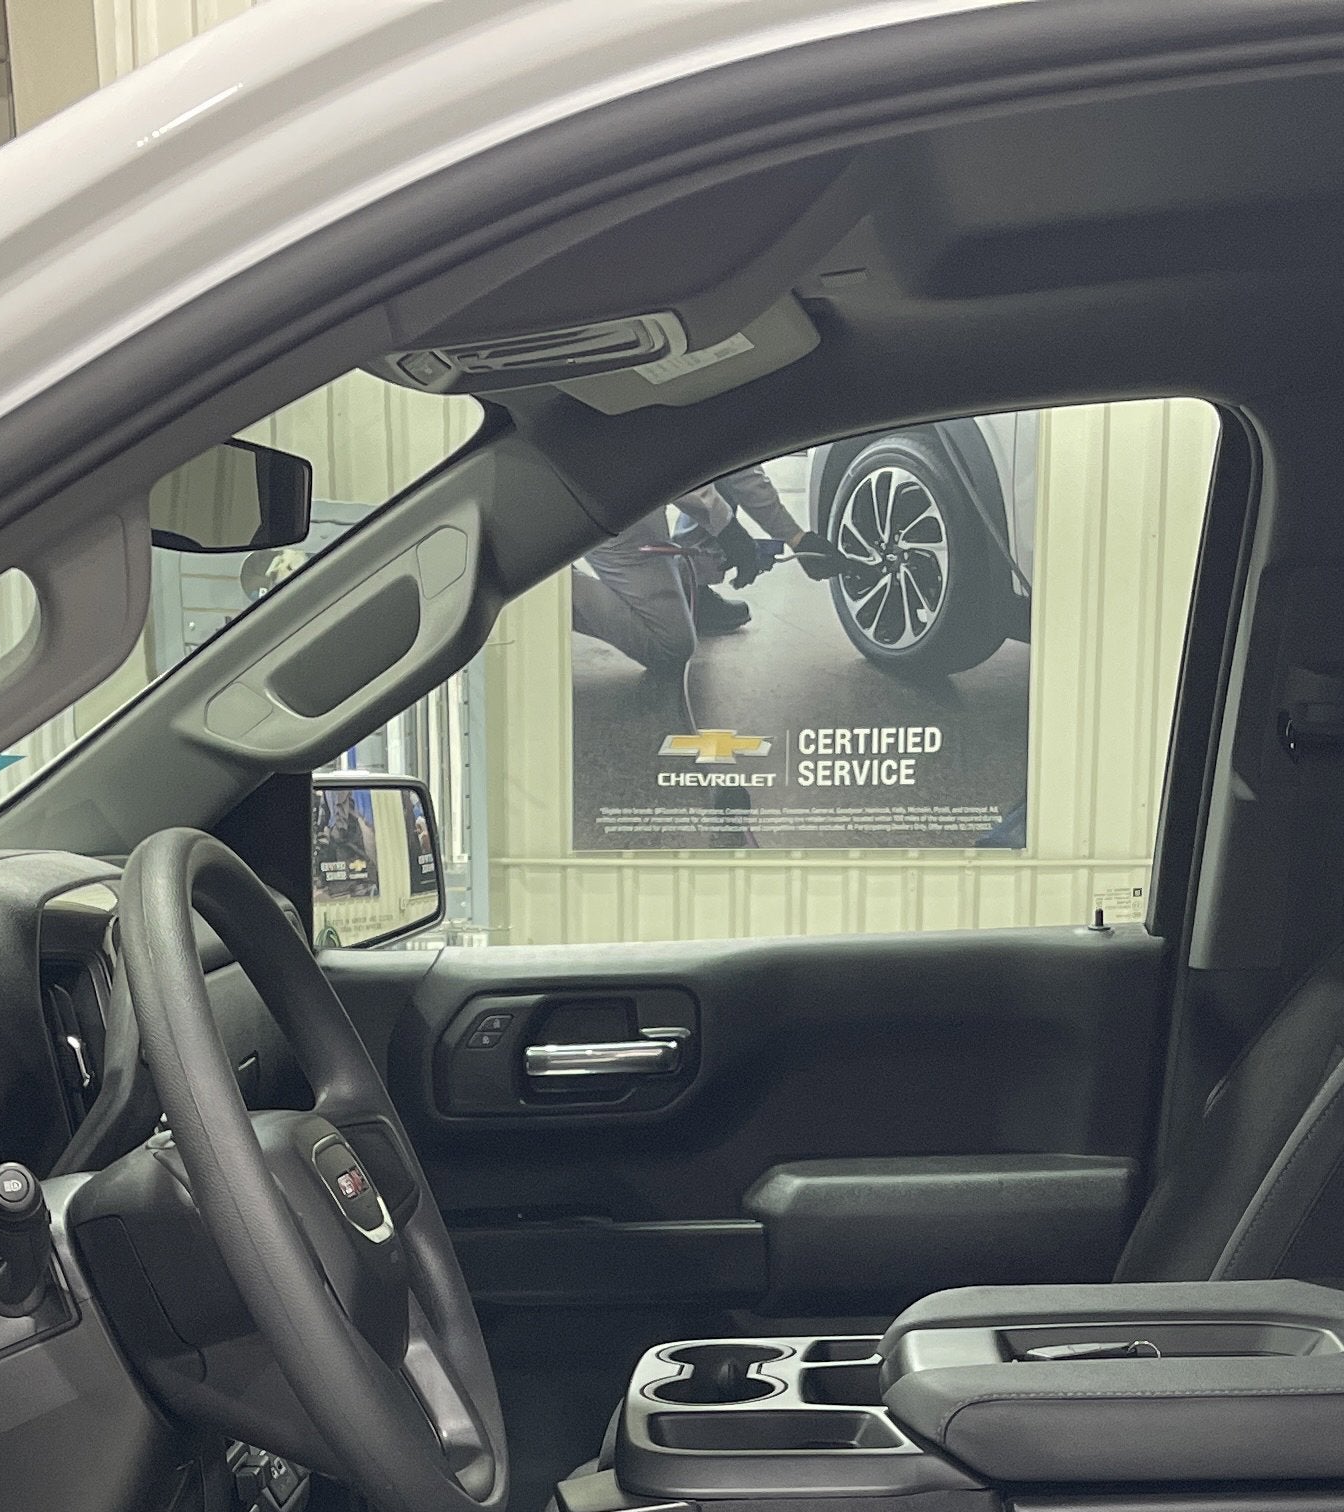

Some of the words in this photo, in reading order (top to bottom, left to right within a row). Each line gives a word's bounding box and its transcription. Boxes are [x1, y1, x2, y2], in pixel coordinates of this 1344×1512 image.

[798, 727, 942, 755] CERTIFIED
[657, 772, 777, 788] CHEVROLET
[797, 759, 916, 787] SERVICE
